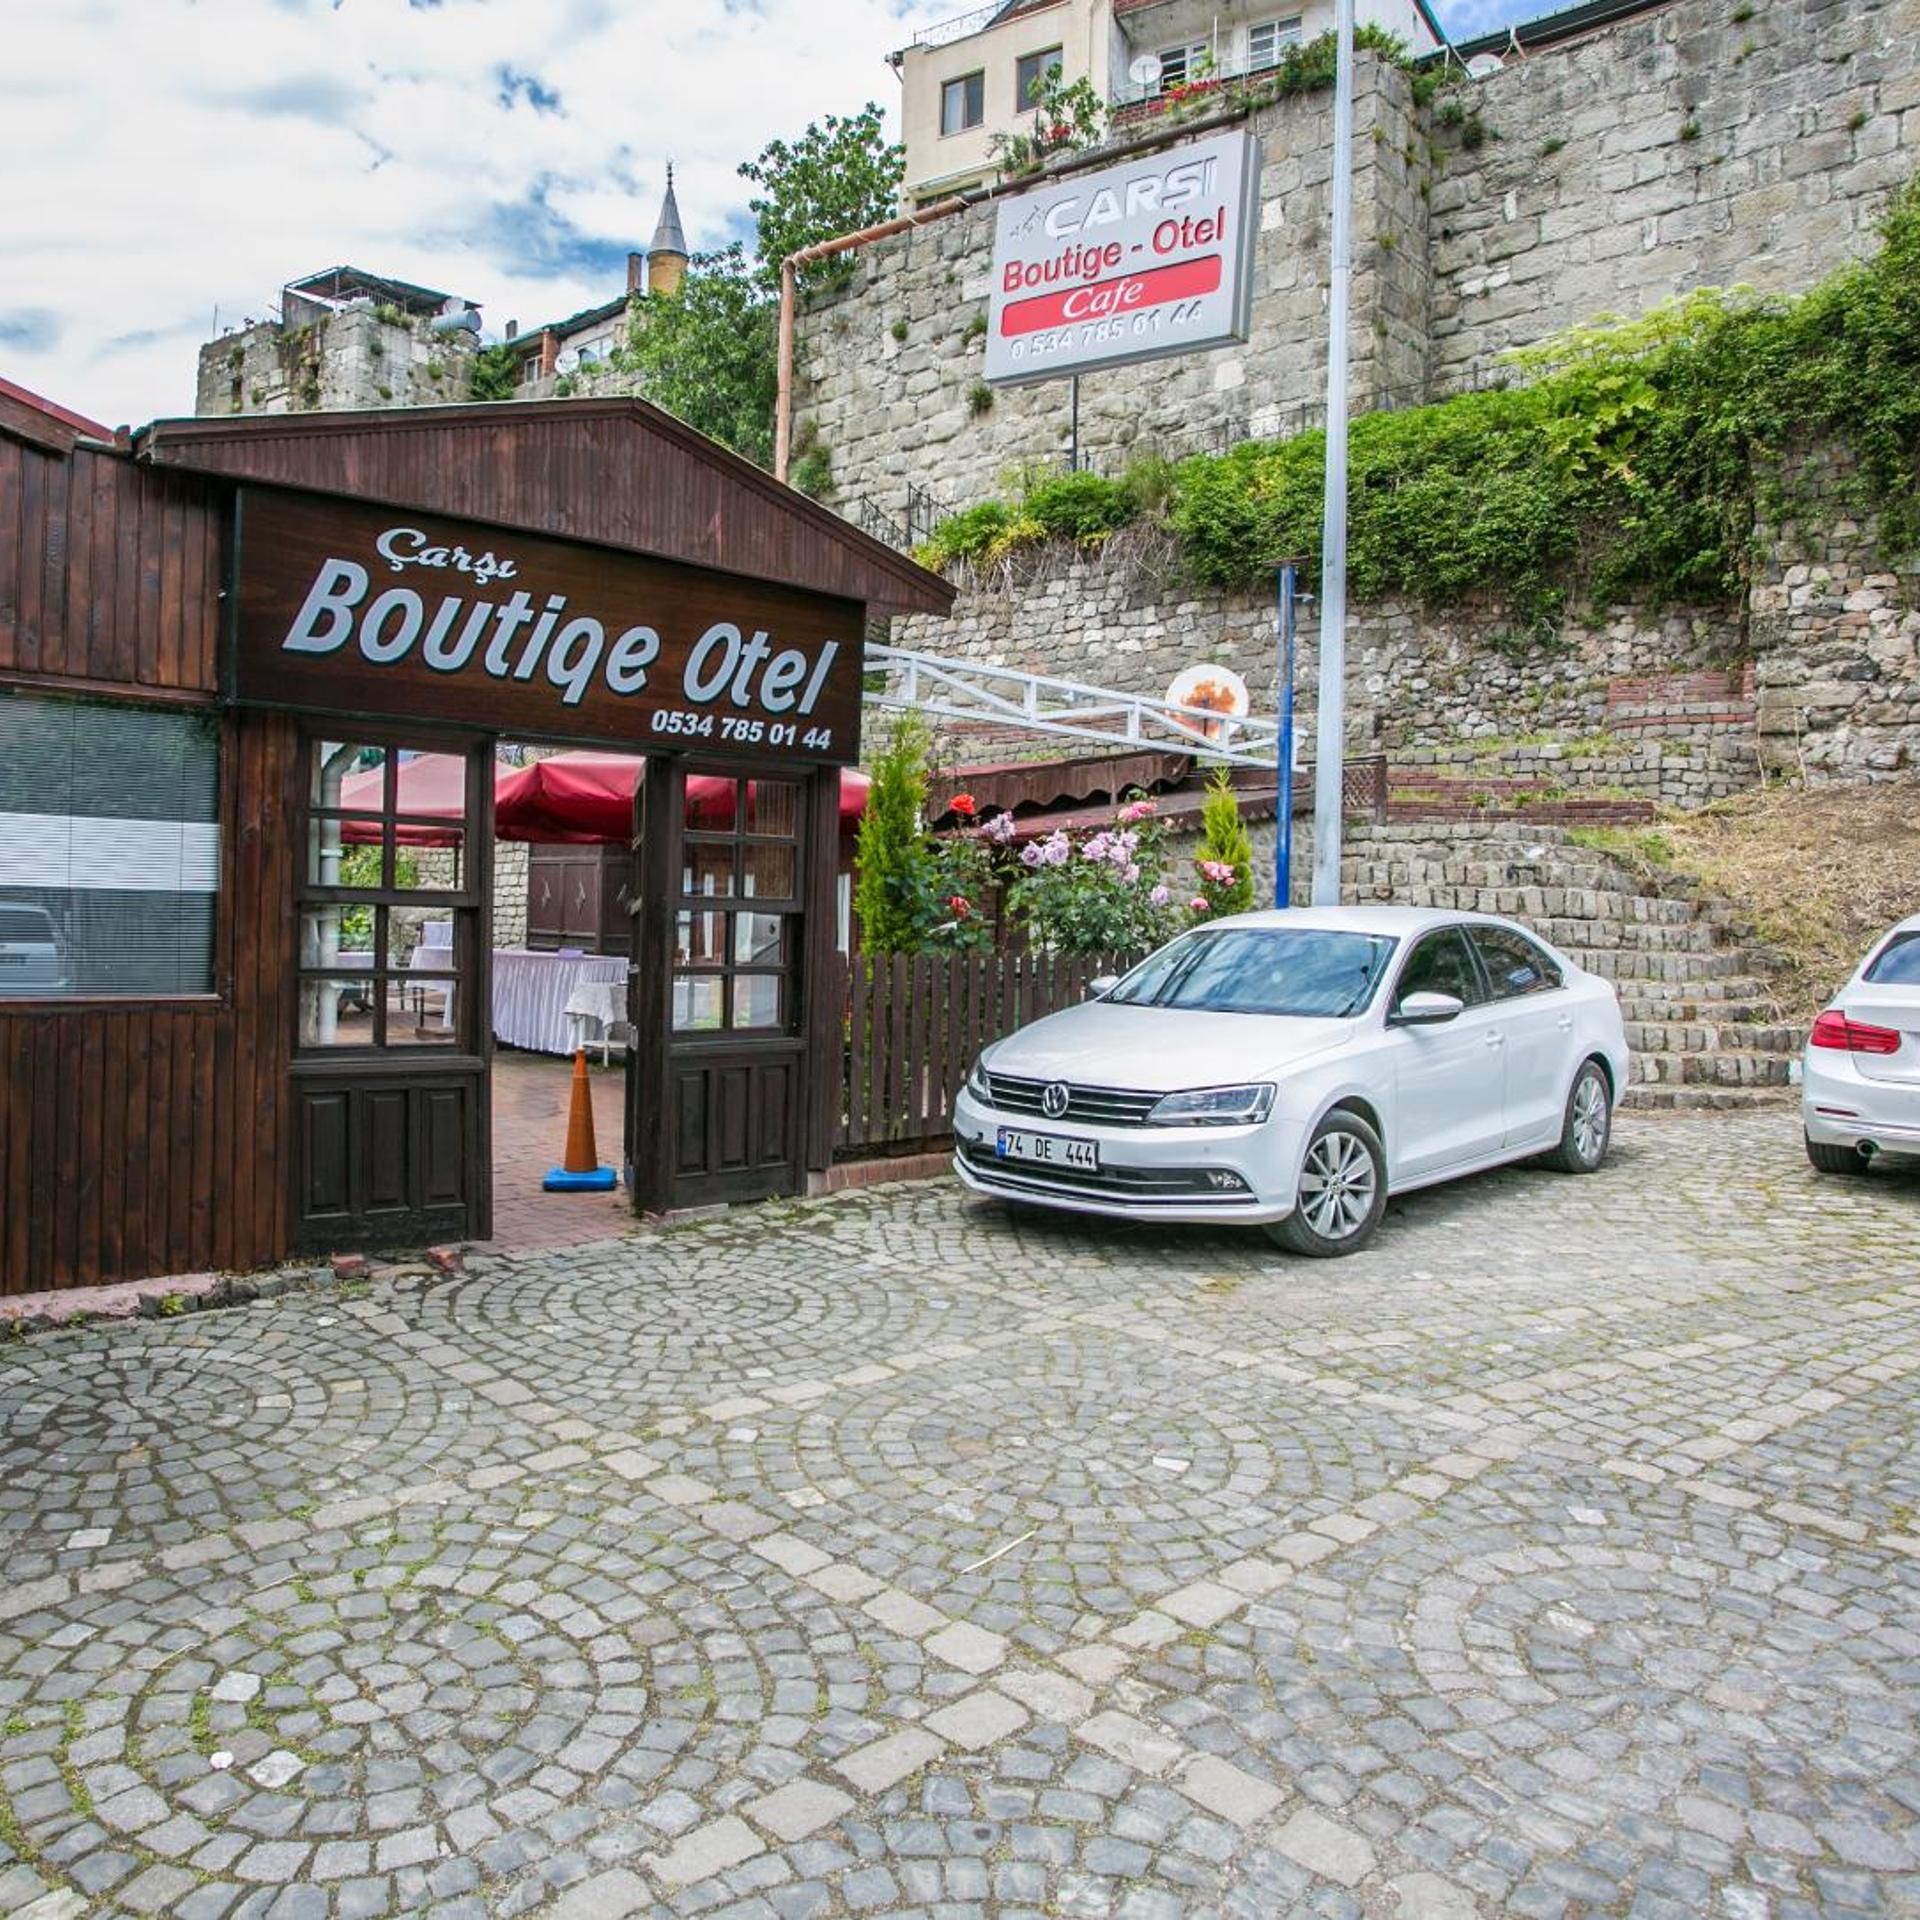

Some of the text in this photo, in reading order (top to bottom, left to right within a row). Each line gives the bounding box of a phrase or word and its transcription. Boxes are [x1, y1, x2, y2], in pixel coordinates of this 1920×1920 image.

[1003, 241, 1122, 292] Boutige
[1152, 206, 1225, 256] Otel
[1062, 277, 1144, 319] Cafe
[1010, 300, 1202, 360] 0 534 785 01 44
[375, 528, 517, 585] Çarşı
[282, 557, 839, 717] Boutiqe Otel
[651, 709, 832, 750] 0534 785 01 44
[1007, 1133, 1023, 1154] 74
[1035, 1138, 1053, 1159] DE
[1066, 1143, 1093, 1166] 444
